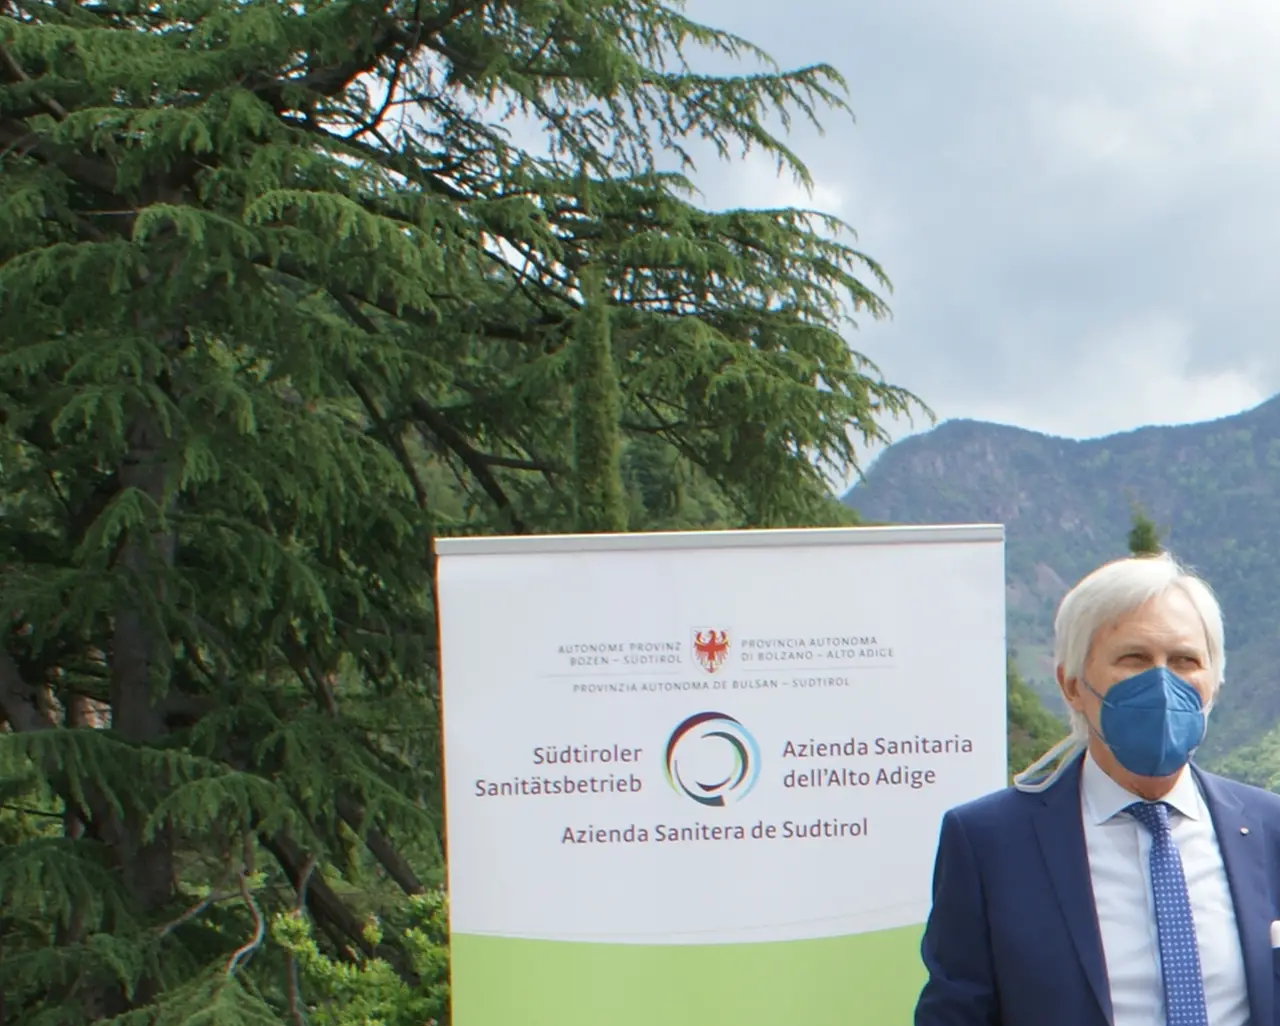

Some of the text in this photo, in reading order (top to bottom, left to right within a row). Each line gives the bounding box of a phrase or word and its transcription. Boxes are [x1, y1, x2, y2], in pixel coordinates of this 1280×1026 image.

[557, 641, 682, 654] AUTONOME PROVINZ
[740, 636, 878, 649] PROVINCIA AUTONOMA
[569, 653, 609, 666] BOZEN
[740, 651, 754, 662] DI
[757, 649, 814, 662] BOLZANO
[826, 647, 856, 660] ALTO
[859, 647, 895, 658] ADIGE
[572, 682, 639, 693] PROVINZIA
[641, 681, 710, 692] AUTONOMA
[712, 680, 728, 690] DE
[731, 678, 778, 690] BULSAN
[533, 744, 643, 765] Südtiroler
[783, 734, 973, 758] Azienda Sanitaria
[475, 773, 642, 797] Sanitätsbetrieb
[783, 766, 936, 789] dell’Alto Adige
[562, 817, 868, 844] Azienda Sanitera de Sudtirol
